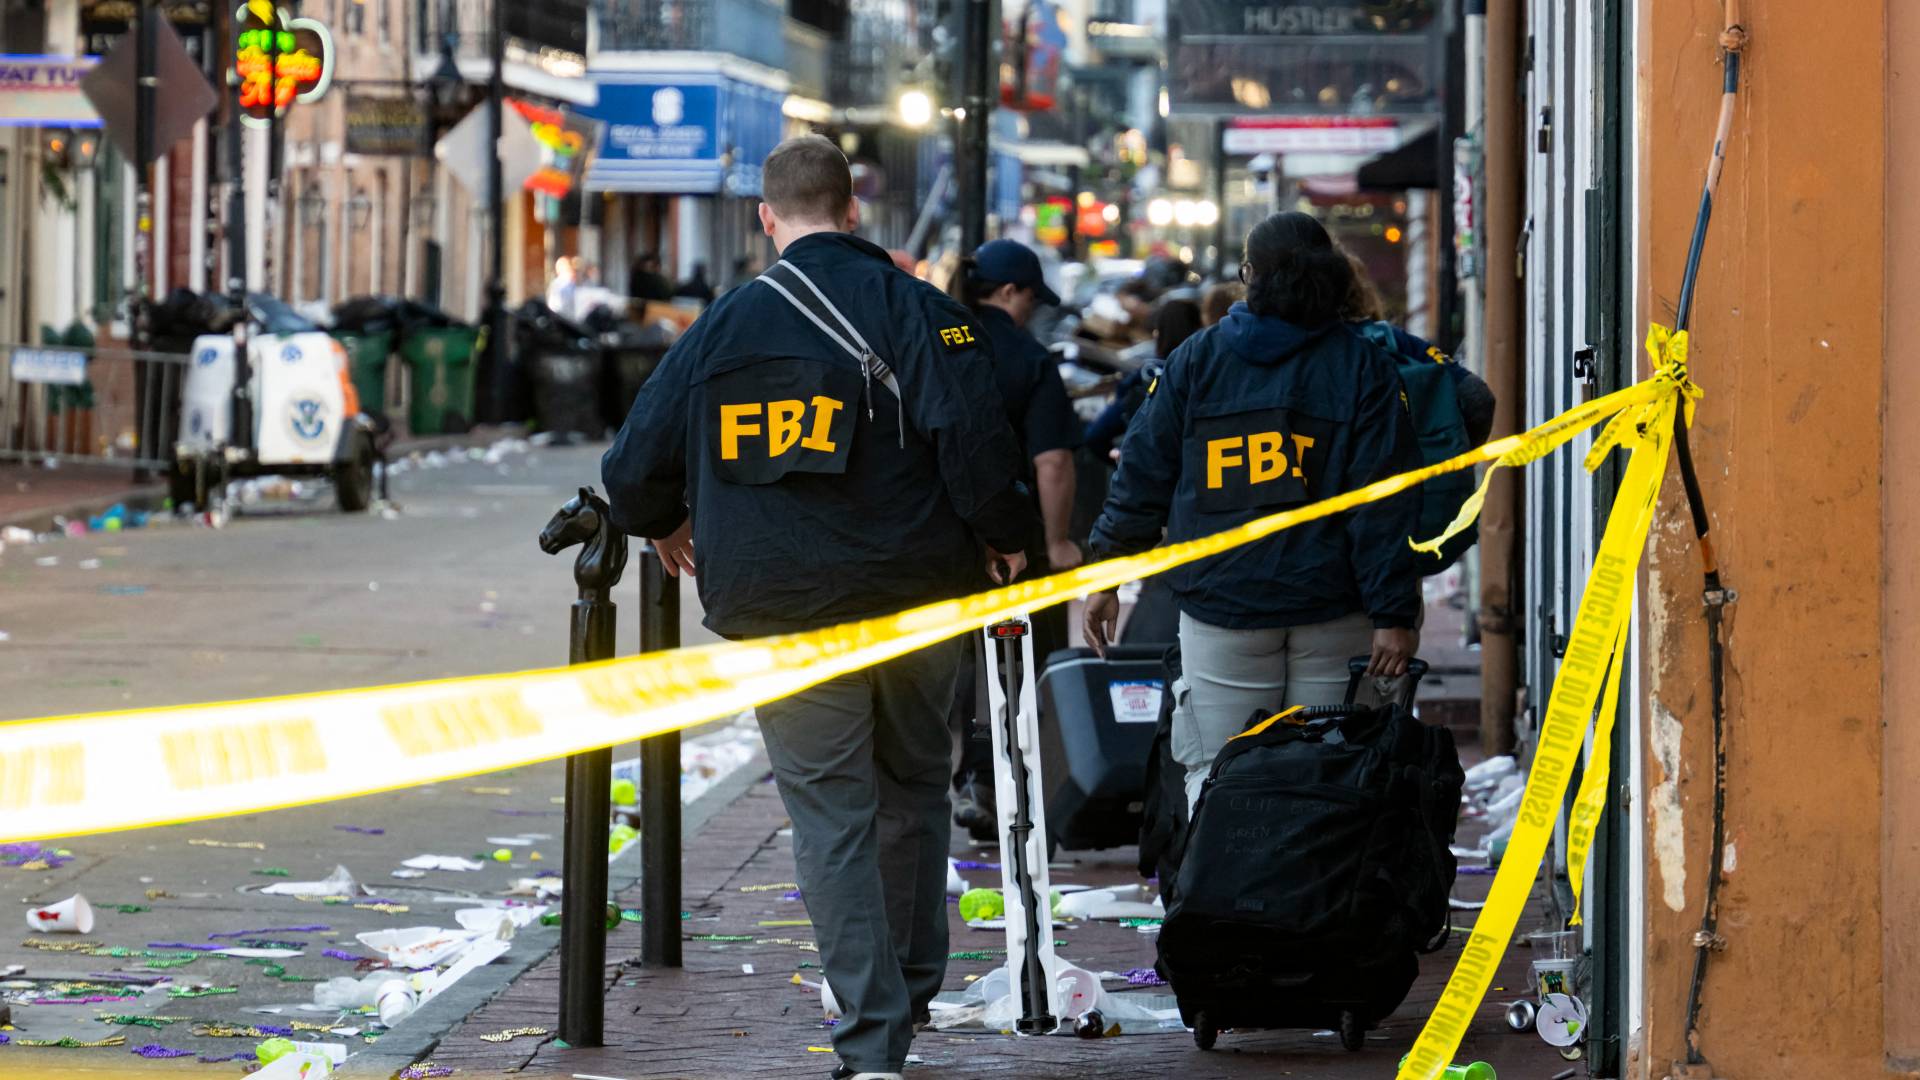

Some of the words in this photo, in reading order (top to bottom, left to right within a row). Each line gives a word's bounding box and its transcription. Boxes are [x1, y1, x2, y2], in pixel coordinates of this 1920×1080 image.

[940, 325, 975, 347] FBI
[720, 395, 843, 460] FBI
[1206, 431, 1315, 489] FBI
